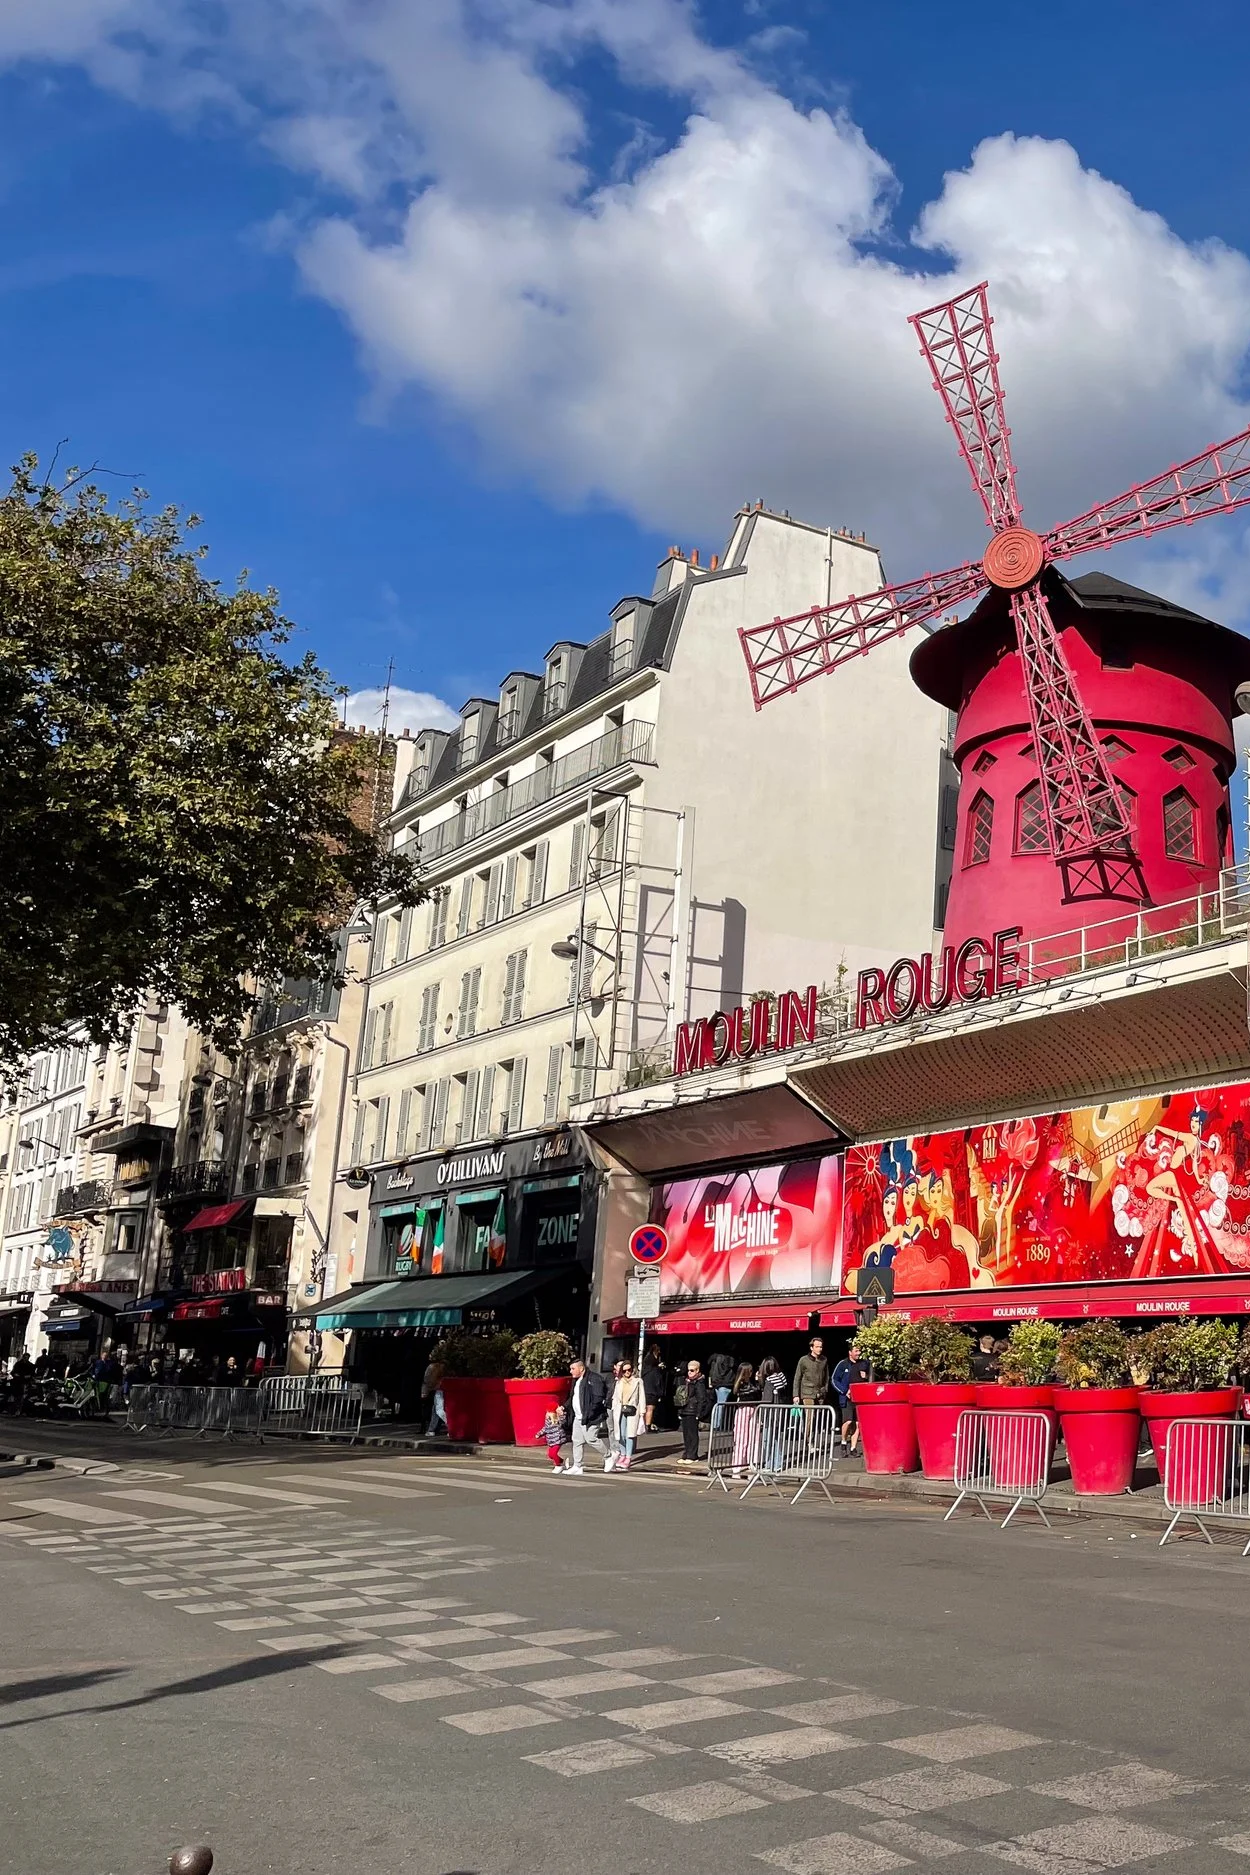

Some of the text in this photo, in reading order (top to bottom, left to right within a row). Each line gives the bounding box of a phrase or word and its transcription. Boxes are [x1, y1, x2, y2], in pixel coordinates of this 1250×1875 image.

[673, 925, 1024, 1075] MOULIN ROUGE
[437, 1151, 506, 1185] O'SULLIVANS
[475, 1212, 580, 1254] FA ZONE
[1025, 1243, 1051, 1265] 1889
[257, 1295, 282, 1304] BAR
[1136, 1301, 1190, 1312] MOULIN ROUGE
[993, 1306, 1039, 1317] MOULIN ROUGE
[729, 1320, 762, 1329] MOULIN ROUGE
